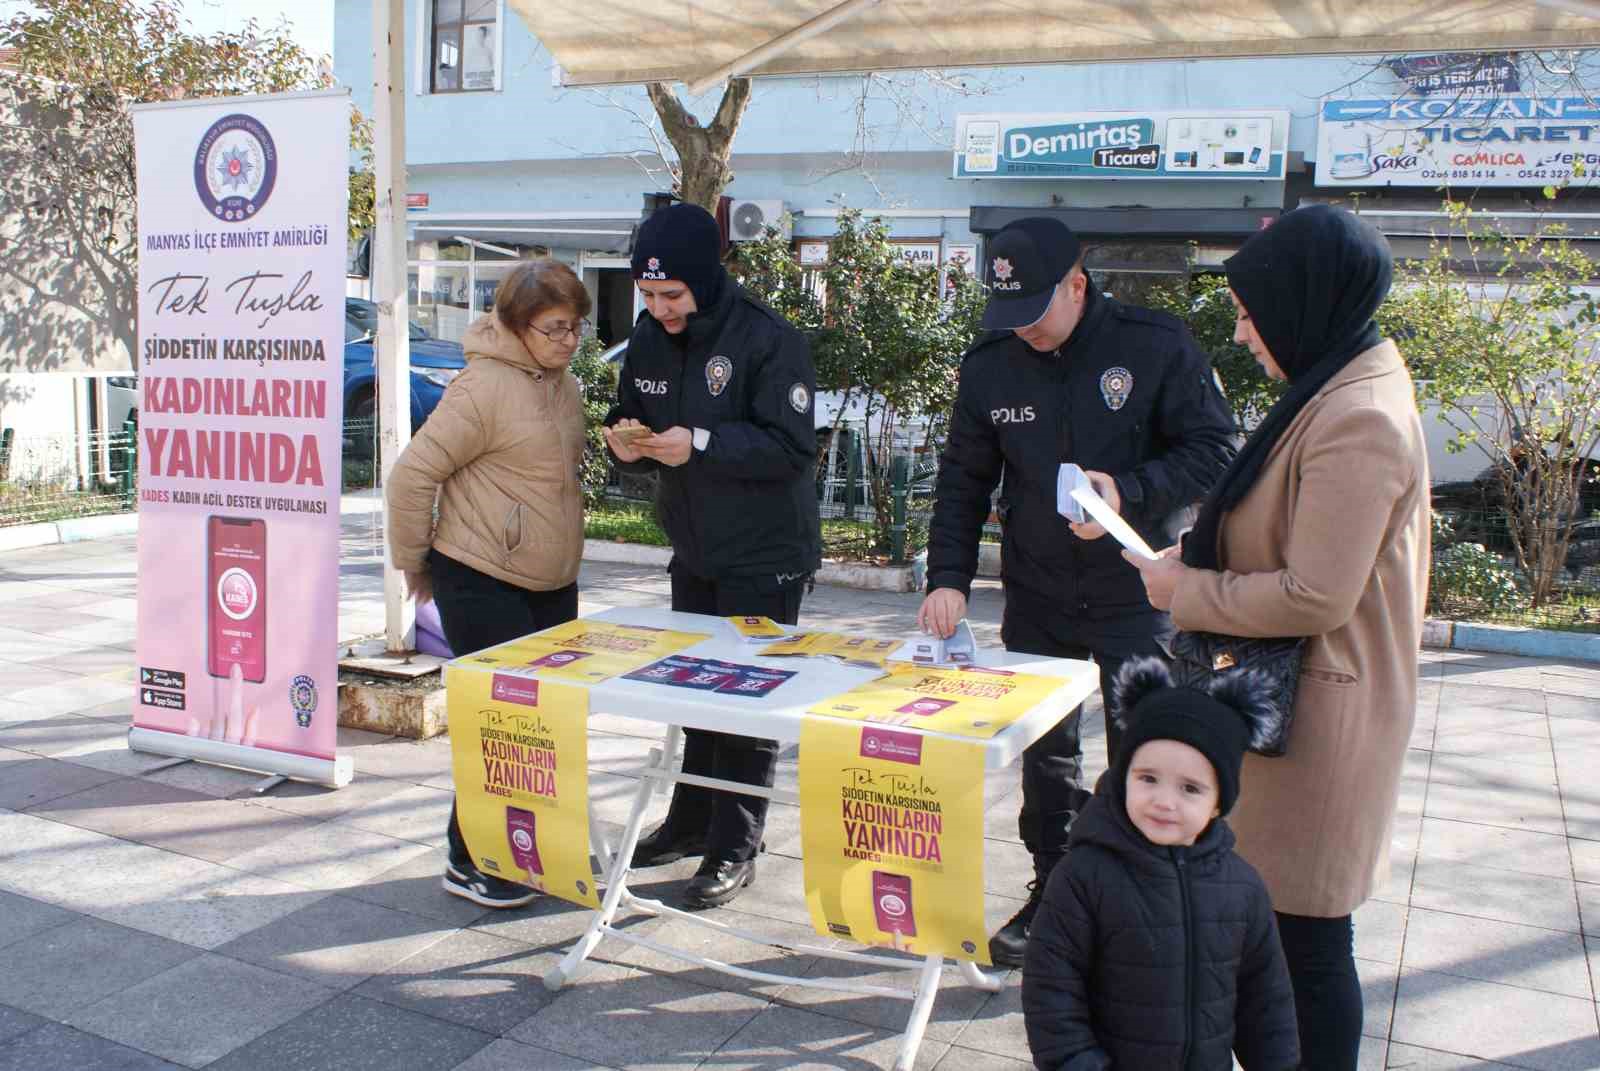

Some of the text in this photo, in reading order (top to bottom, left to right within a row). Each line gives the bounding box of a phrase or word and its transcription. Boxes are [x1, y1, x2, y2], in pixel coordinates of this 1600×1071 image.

[1389, 100, 1564, 119] KOZAN
[1010, 123, 1141, 159] Demirtaş
[1420, 123, 1592, 142] TİCARET
[1099, 149, 1157, 166] Ticaret
[1518, 170, 1546, 178] 0542
[147, 225, 328, 253] MANYAS İLÇE EMNİYET AMİRLİĞİ
[148, 270, 324, 329] Tek Tuşla
[145, 333, 326, 367] ŞİDDETİN KARŞISINDA
[144, 376, 327, 419] KADINLARIN
[144, 428, 324, 487] YANINDA
[173, 491, 201, 505] KADIN
[203, 491, 224, 506] ACİL
[227, 496, 262, 510] DESTEK
[265, 498, 327, 514] UYGULAMASI
[481, 739, 557, 771] KADINLARIN
[484, 758, 557, 798] YANINDA
[484, 784, 513, 798] KADES
[841, 768, 878, 789] Tek
[842, 799, 942, 834] KADINLARIN
[844, 820, 942, 863] YANINDA
[844, 848, 881, 863] KADES
